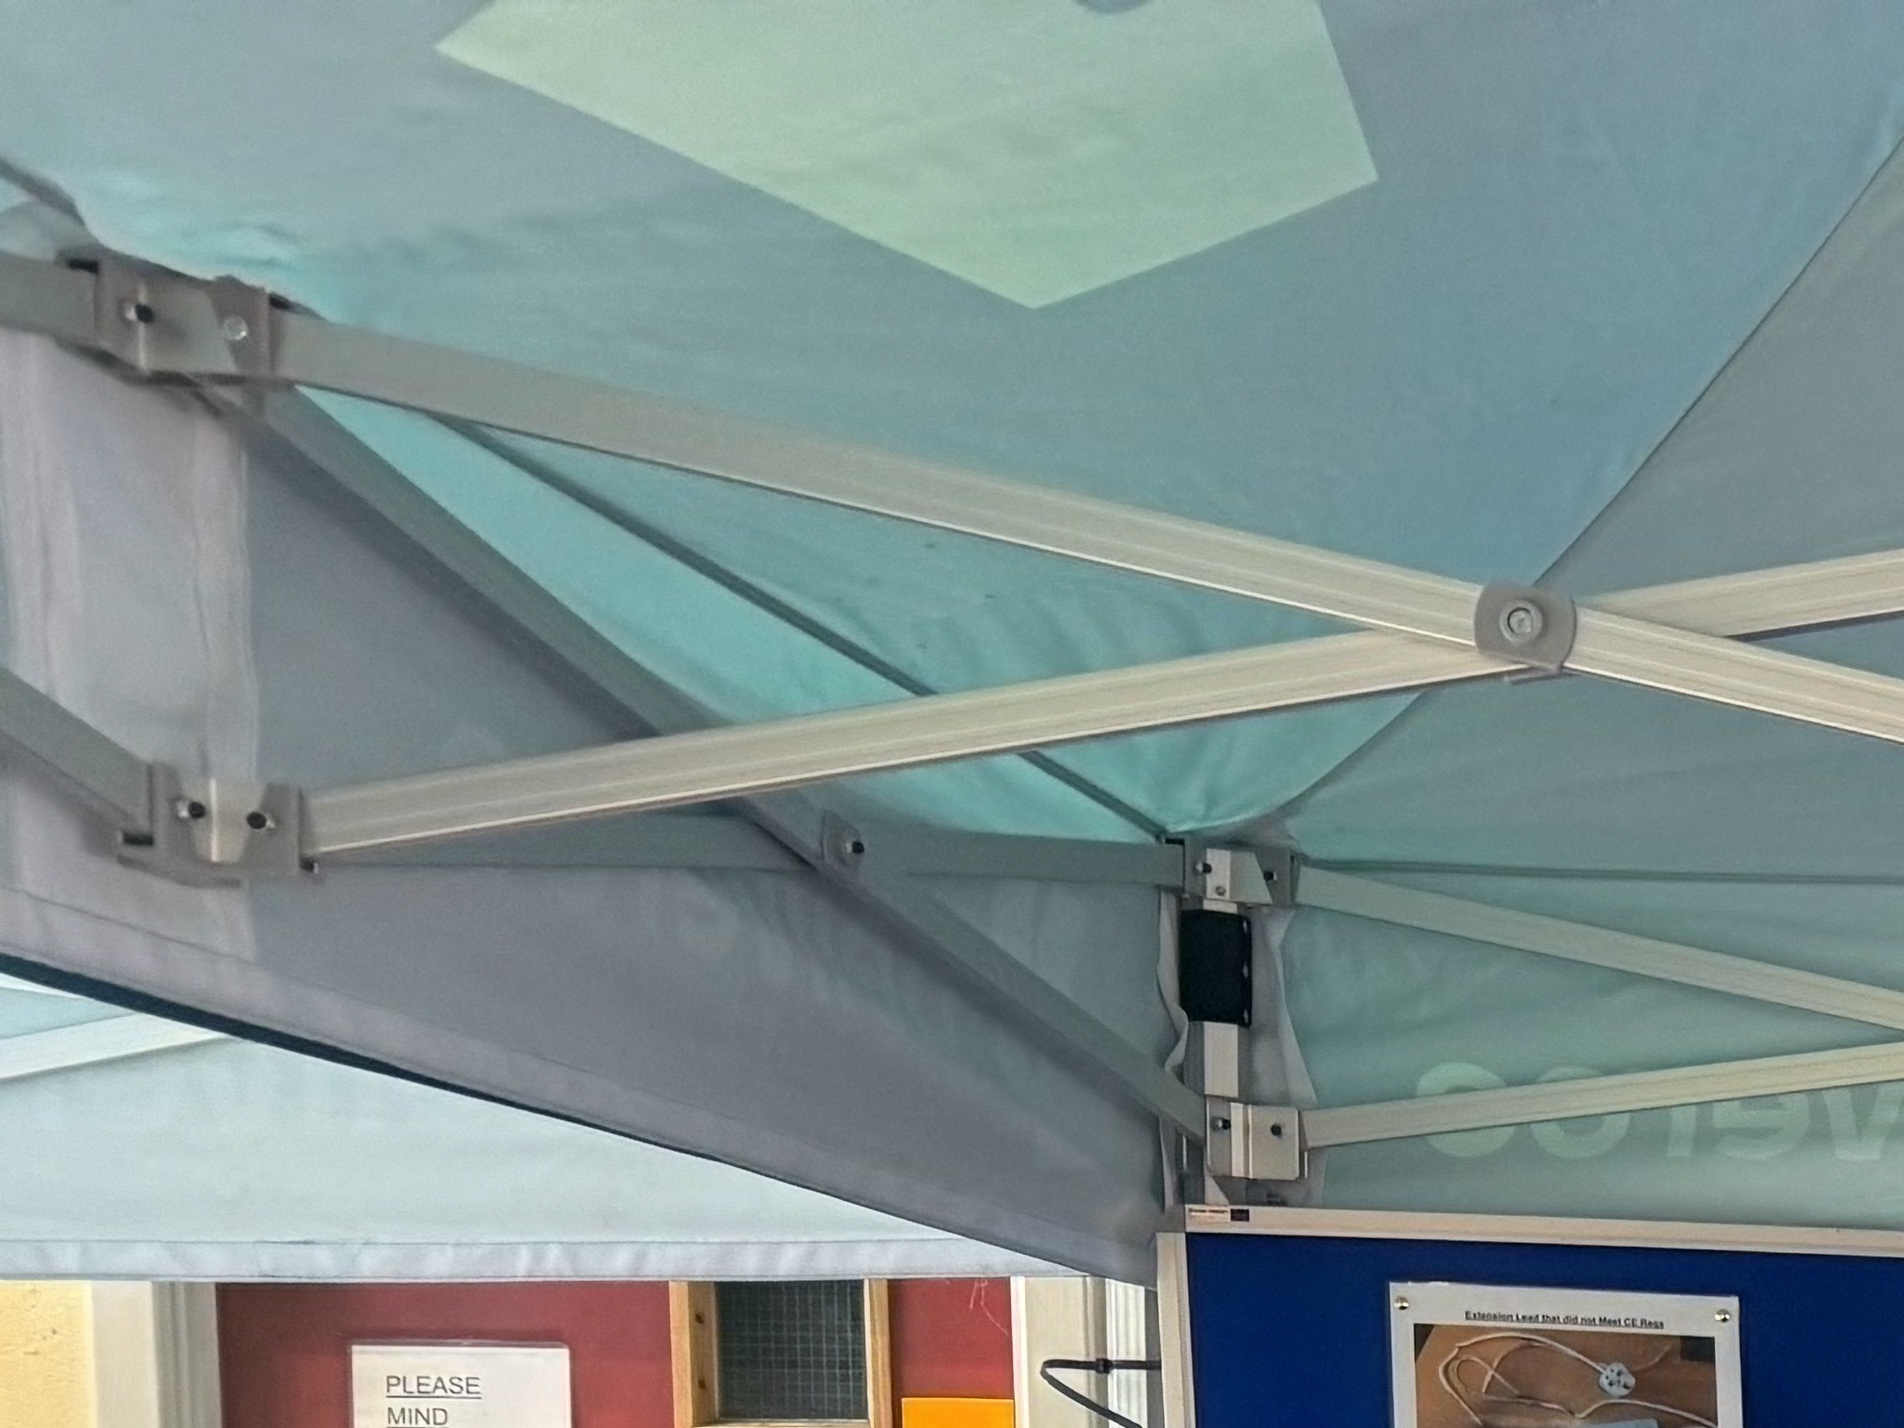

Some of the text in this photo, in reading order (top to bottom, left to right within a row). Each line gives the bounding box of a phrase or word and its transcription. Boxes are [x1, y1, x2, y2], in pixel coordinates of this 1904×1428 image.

[1465, 1311, 1512, 1322] Extension
[1515, 1312, 1539, 1323] Lead
[1542, 1314, 1561, 1324] that
[1564, 1315, 1578, 1324] did
[1581, 1316, 1596, 1325] not
[1599, 1317, 1622, 1327] Meet
[386, 1375, 482, 1396] PLEASE
[387, 1407, 448, 1427] MIND
